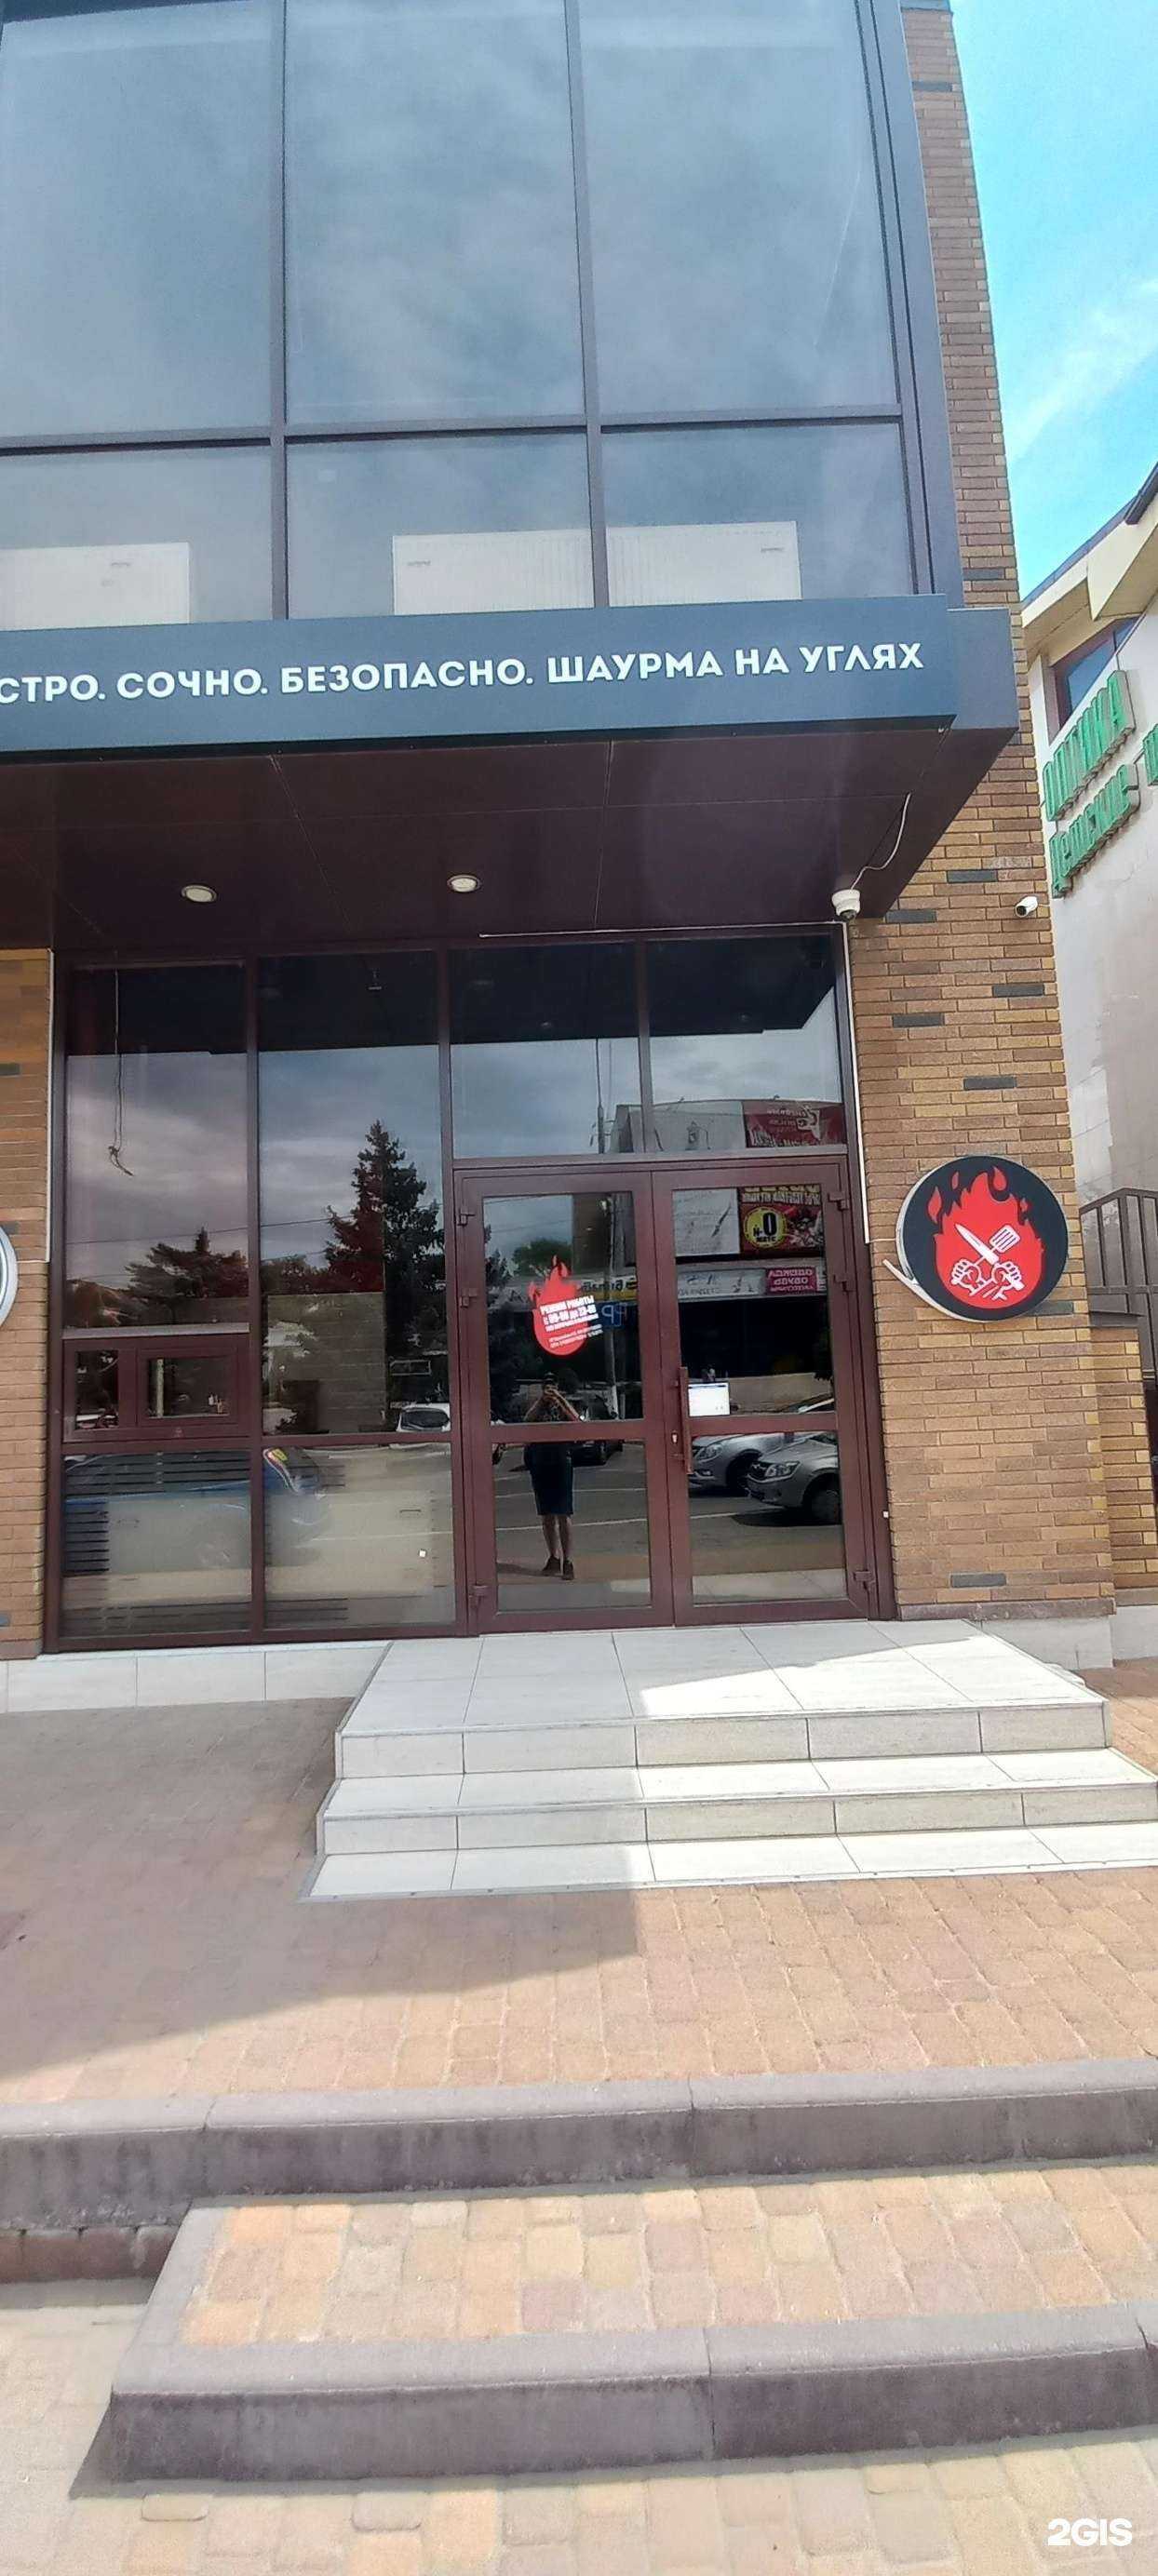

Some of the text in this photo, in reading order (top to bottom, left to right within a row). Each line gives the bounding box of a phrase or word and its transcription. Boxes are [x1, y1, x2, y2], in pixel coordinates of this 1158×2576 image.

[0, 643, 923, 703] СТРО. СОЧНО. БЕЗОПАСНО. ШАУРМА НА УГЛЯХ
